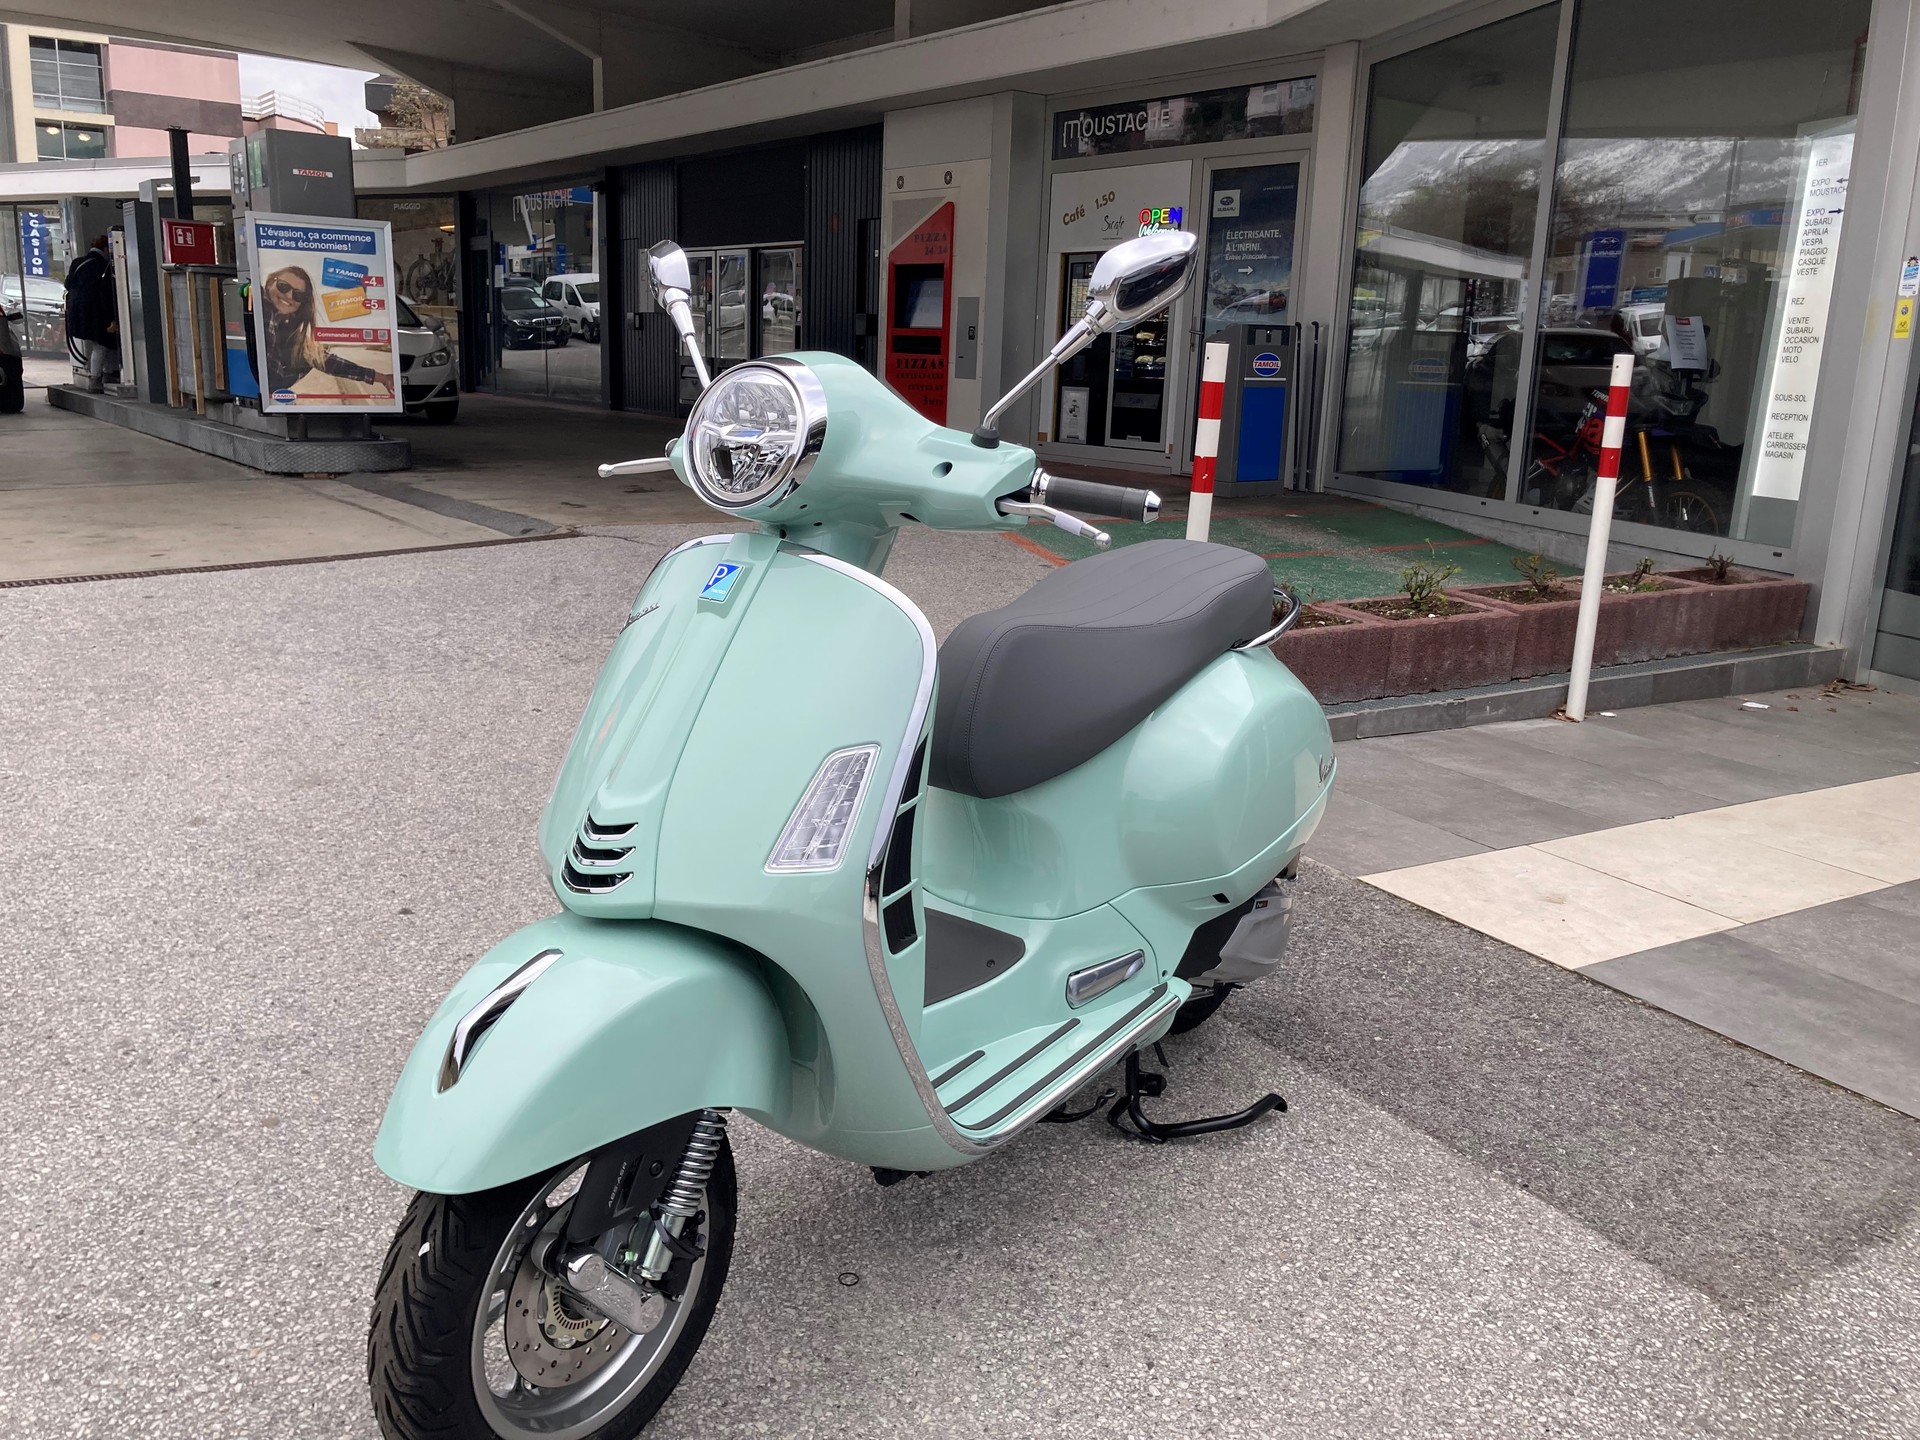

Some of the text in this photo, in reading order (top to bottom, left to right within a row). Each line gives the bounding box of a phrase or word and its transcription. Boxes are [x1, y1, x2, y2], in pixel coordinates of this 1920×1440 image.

[297, 168, 329, 177] TAMOIL
[1811, 177, 1831, 187] EXPO
[80, 198, 89, 208] 4
[393, 202, 421, 211] PIAGGIO
[1063, 191, 1116, 226] Café 1.50
[1806, 207, 1826, 217] EXPO
[1139, 206, 1182, 226] OPEN
[1804, 217, 1832, 227] SUBARU
[259, 226, 372, 244] L'évasion, ça commence
[1226, 229, 1282, 240] ÉLECTRISANTE.
[1802, 227, 1829, 237] APRILIA
[260, 238, 352, 252] par des économies!
[1801, 237, 1824, 247] VESPA
[1799, 247, 1828, 256] PIAGGIO
[1797, 257, 1826, 266] CASQUE
[1796, 267, 1818, 276] VESTE
[336, 296, 365, 306] TAMOIL
[1791, 297, 1805, 305] REZ
[1788, 316, 1810, 325] VENTE
[317, 331, 350, 339] Commander
[1786, 326, 1814, 335] SUBARU
[1784, 336, 1820, 344] OCCASION
[1782, 346, 1803, 354] MOTO
[896, 358, 944, 369] PIZZAS
[1781, 355, 1799, 364] VELO
[1774, 393, 1807, 403] SOUS-SOL
[1770, 412, 1809, 422] RECEPTION
[1767, 431, 1794, 440] ATELIER
[1764, 450, 1795, 460] MAGASIN
[708, 565, 728, 586] P
